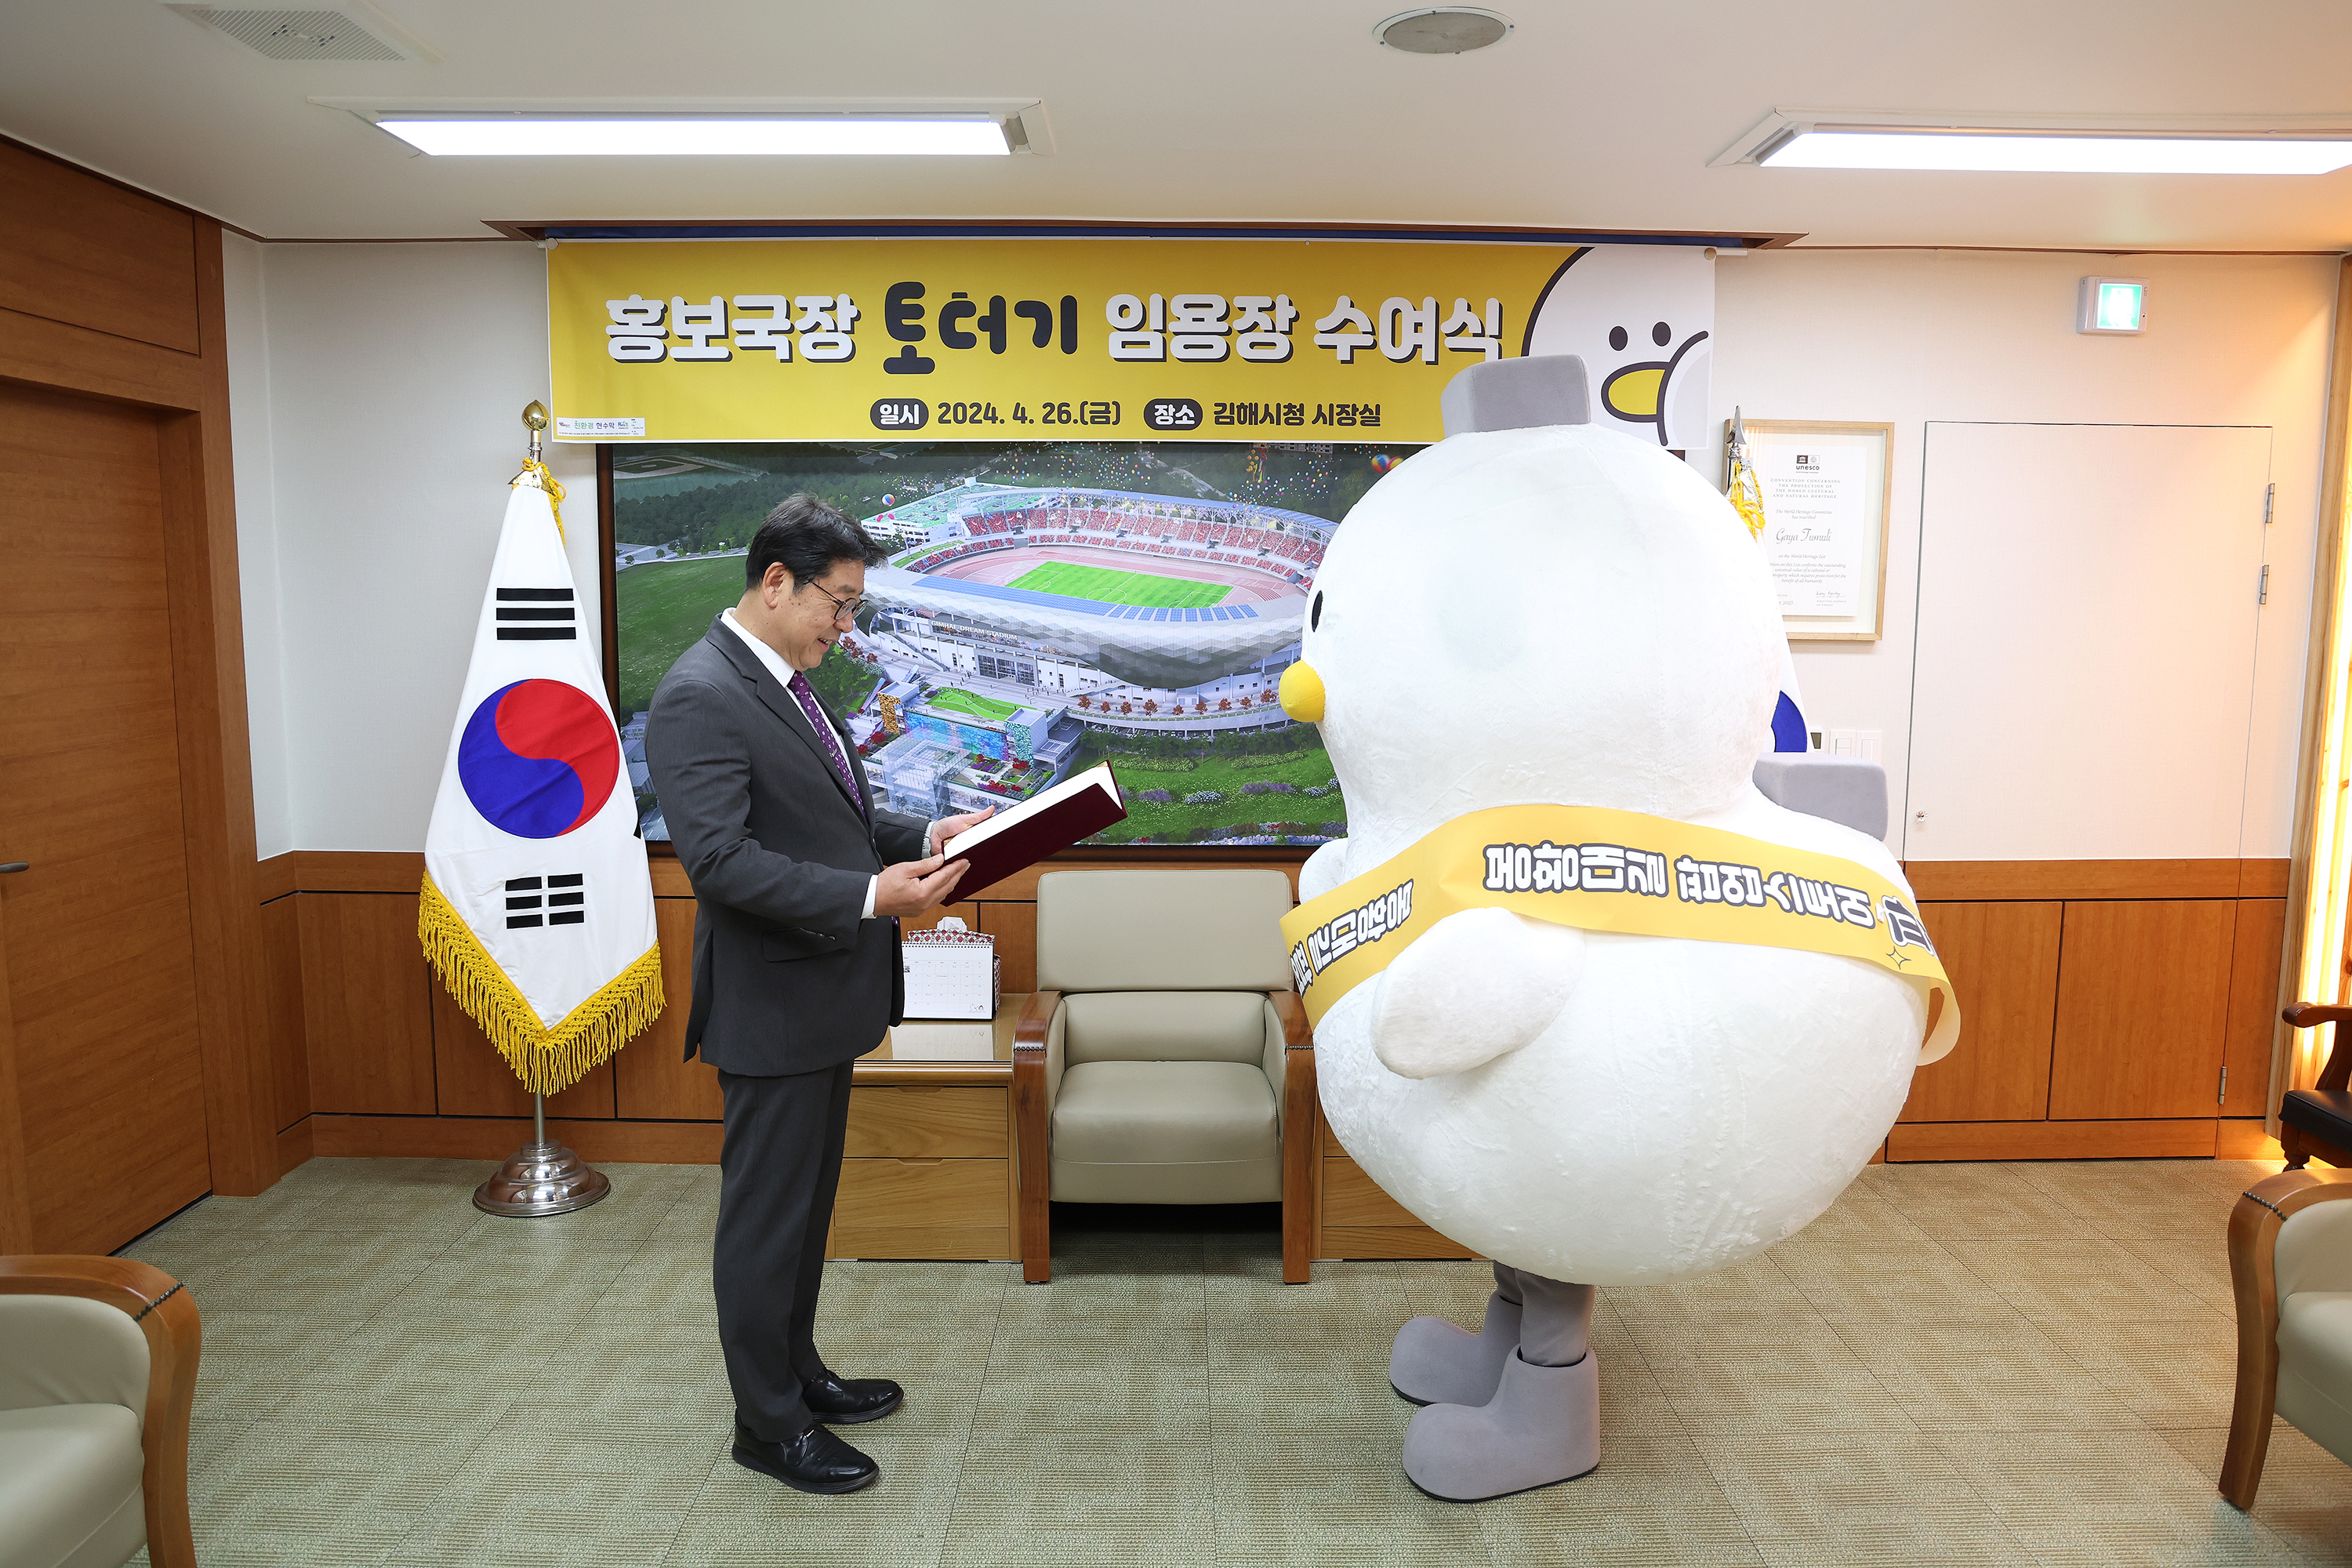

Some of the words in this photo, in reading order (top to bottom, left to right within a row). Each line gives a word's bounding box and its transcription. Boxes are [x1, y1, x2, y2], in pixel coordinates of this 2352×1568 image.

[605, 293, 861, 363] 홍보국장
[883, 281, 1078, 375] 토더기
[1105, 292, 1299, 364] 임용장
[1312, 294, 1504, 366] 수여식
[574, 420, 593, 430] 친환경
[878, 402, 921, 425] 일시
[938, 402, 1005, 425] 2024.
[1012, 402, 1035, 425] 4.
[1153, 402, 1196, 426] 장소
[1213, 401, 1306, 427] 김해시청
[1312, 401, 1381, 426] 시장실
[1776, 527, 1799, 544] Gaya
[1800, 528, 1831, 541] Tumuli
[931, 620, 958, 630] GIMHAE
[960, 626, 985, 634] DREAM
[986, 630, 1018, 641] STADIUM
[1483, 840, 1668, 898] 봉황대길
[1676, 855, 1876, 930] 팝업스토어
